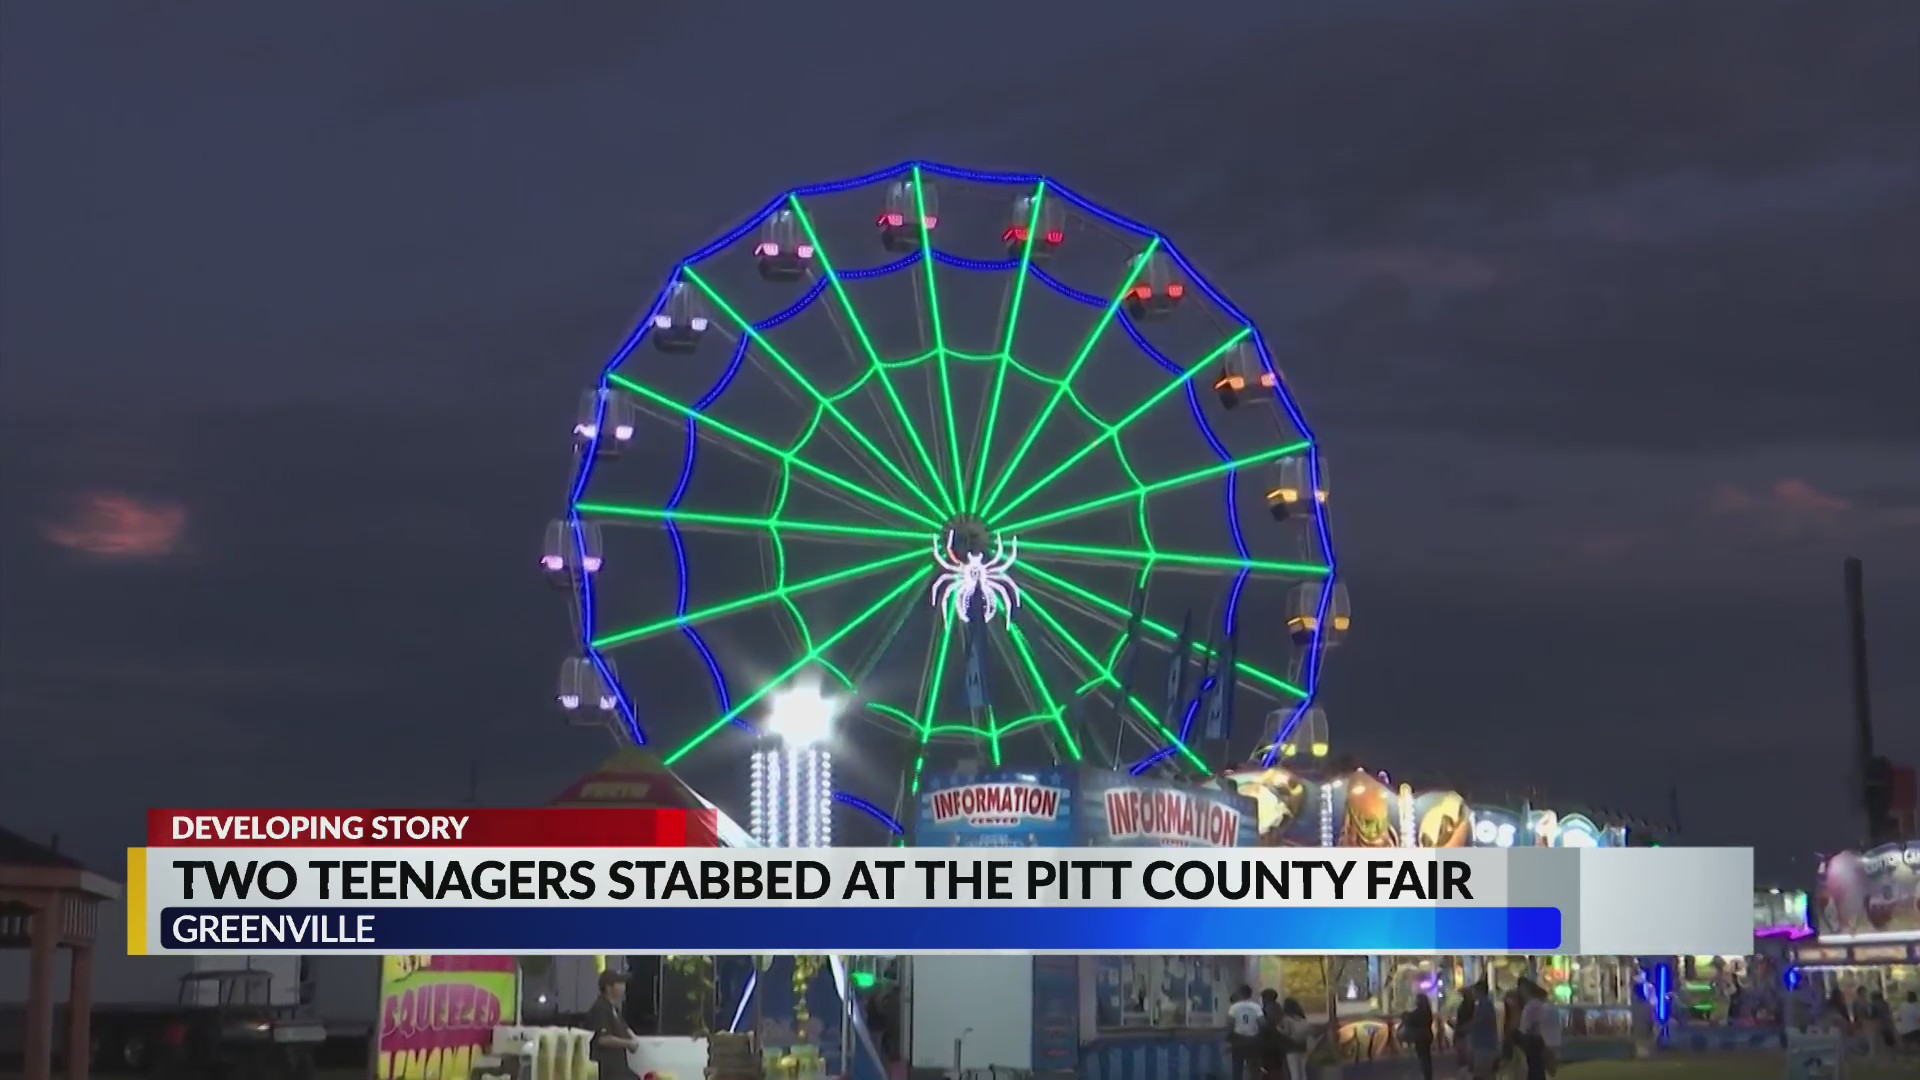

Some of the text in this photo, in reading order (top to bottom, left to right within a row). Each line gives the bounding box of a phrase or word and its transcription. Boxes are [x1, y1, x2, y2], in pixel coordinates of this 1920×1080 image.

[934, 787, 1058, 819] INFORMATION
[1106, 791, 1237, 847] INFORMATION
[380, 983, 501, 1037] SQUEEZED
